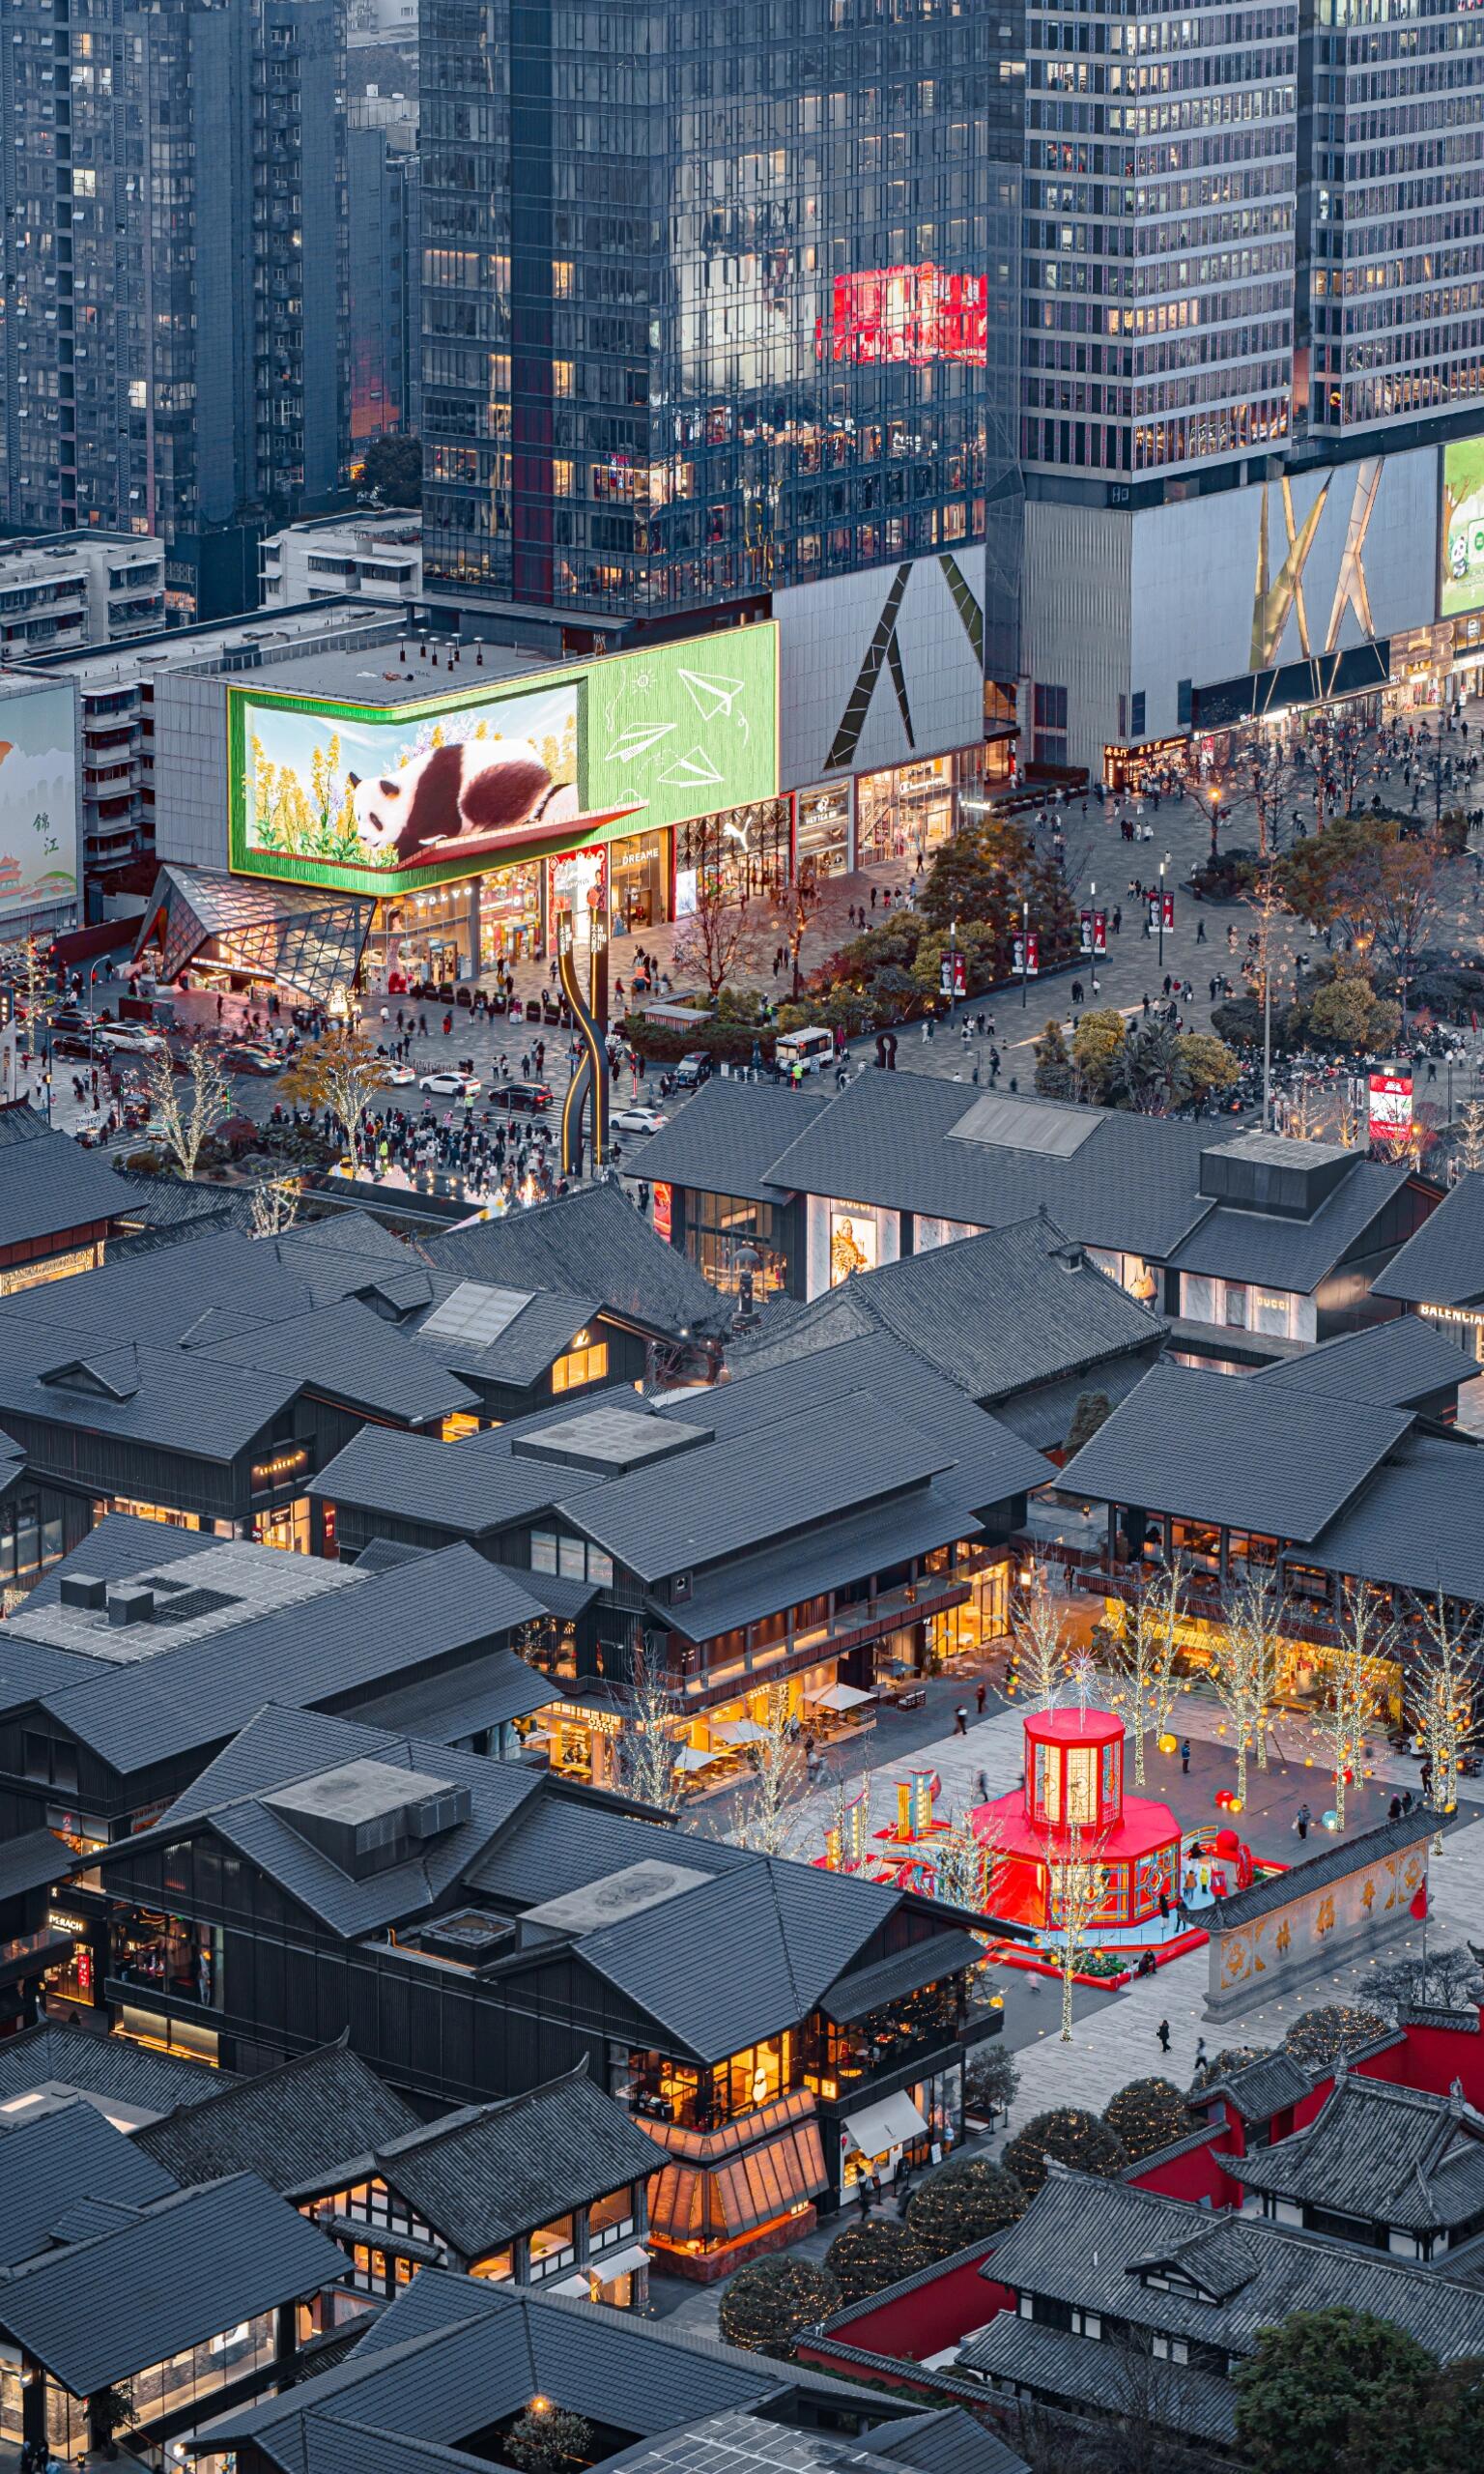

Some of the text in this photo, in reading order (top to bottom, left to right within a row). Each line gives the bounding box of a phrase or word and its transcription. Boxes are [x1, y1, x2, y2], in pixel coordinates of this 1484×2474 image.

[622, 848, 659, 867] DREAME
[415, 887, 472, 907] VOLVO
[1257, 1297, 1290, 1310] GUCCI
[1420, 1305, 1484, 1326] BALENCIA
